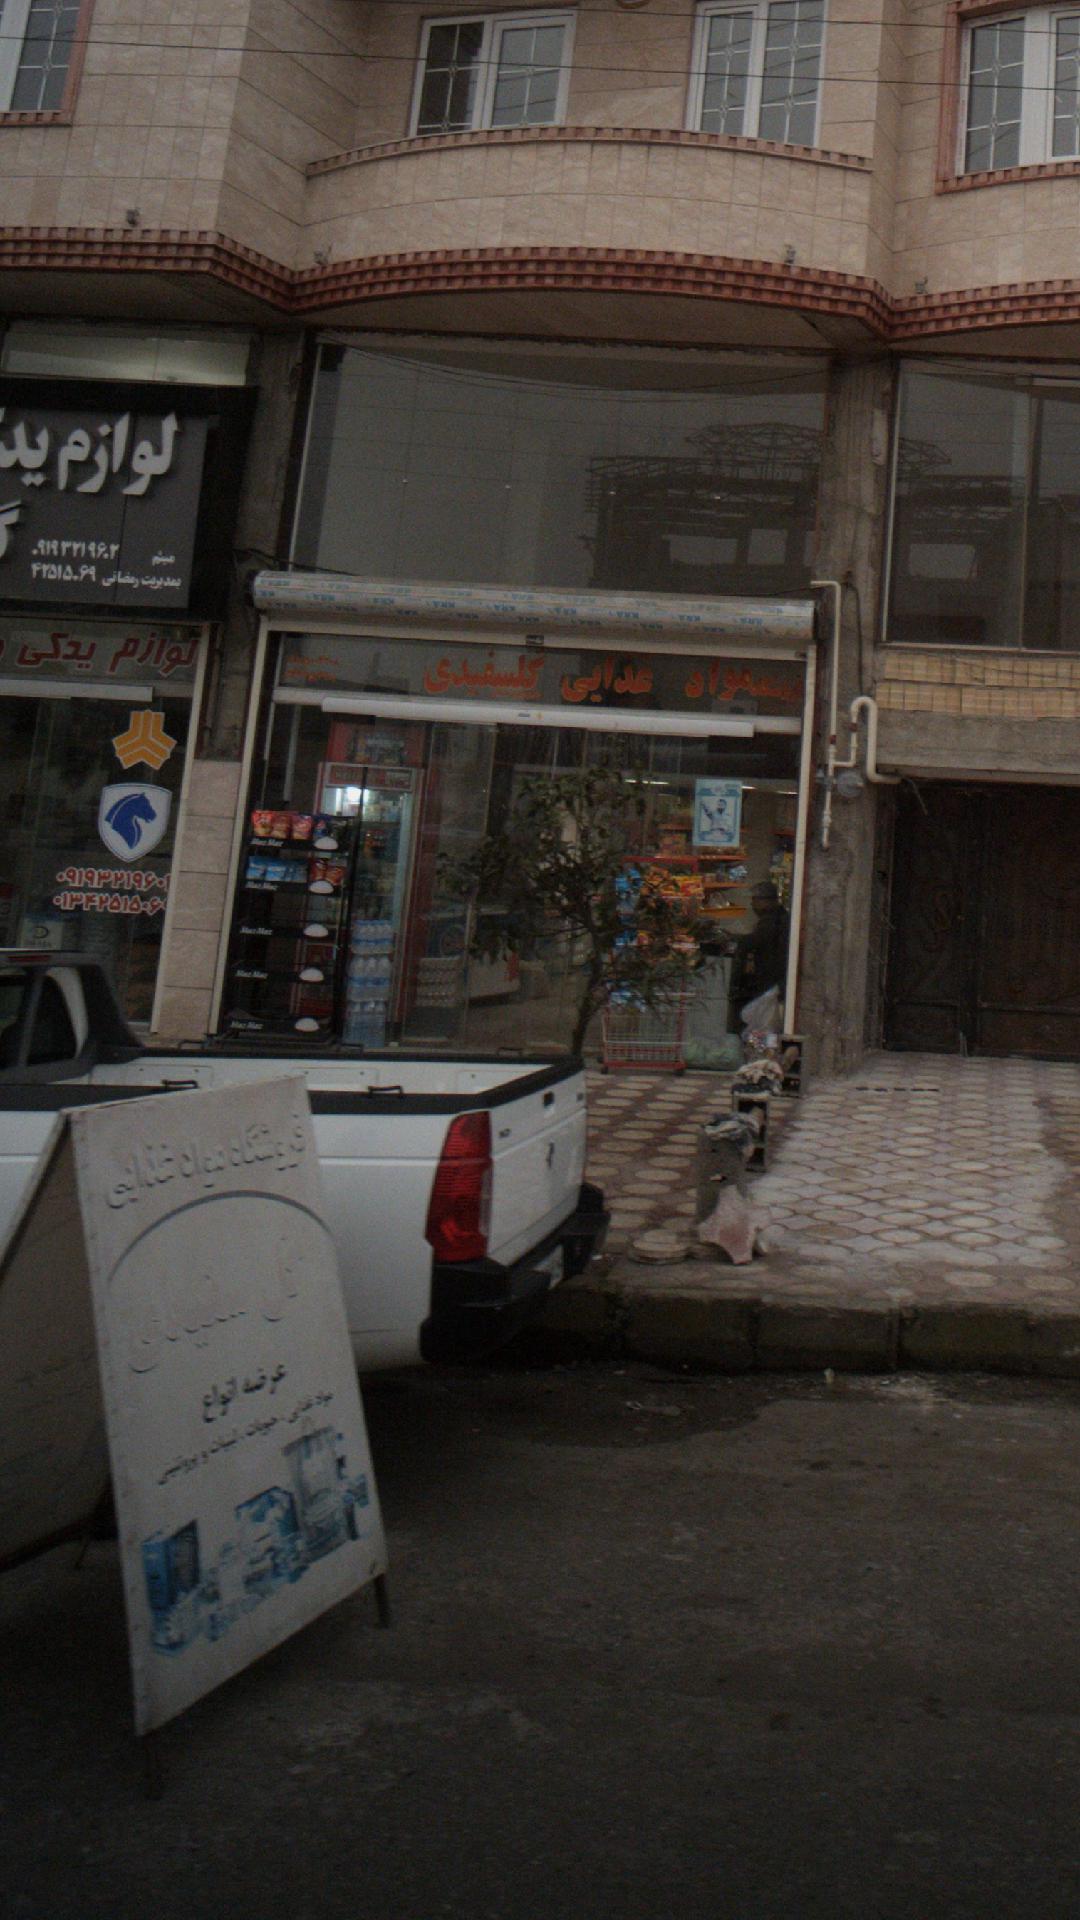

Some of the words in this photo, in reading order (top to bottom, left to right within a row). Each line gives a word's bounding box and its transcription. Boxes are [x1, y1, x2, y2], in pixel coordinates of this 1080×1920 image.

[57, 411, 179, 496] لوازم
[16, 632, 96, 669] یدکی
[107, 632, 200, 677] لوازم
[202, 1377, 238, 1423] انواع
[243, 1364, 287, 1395] عرضه
